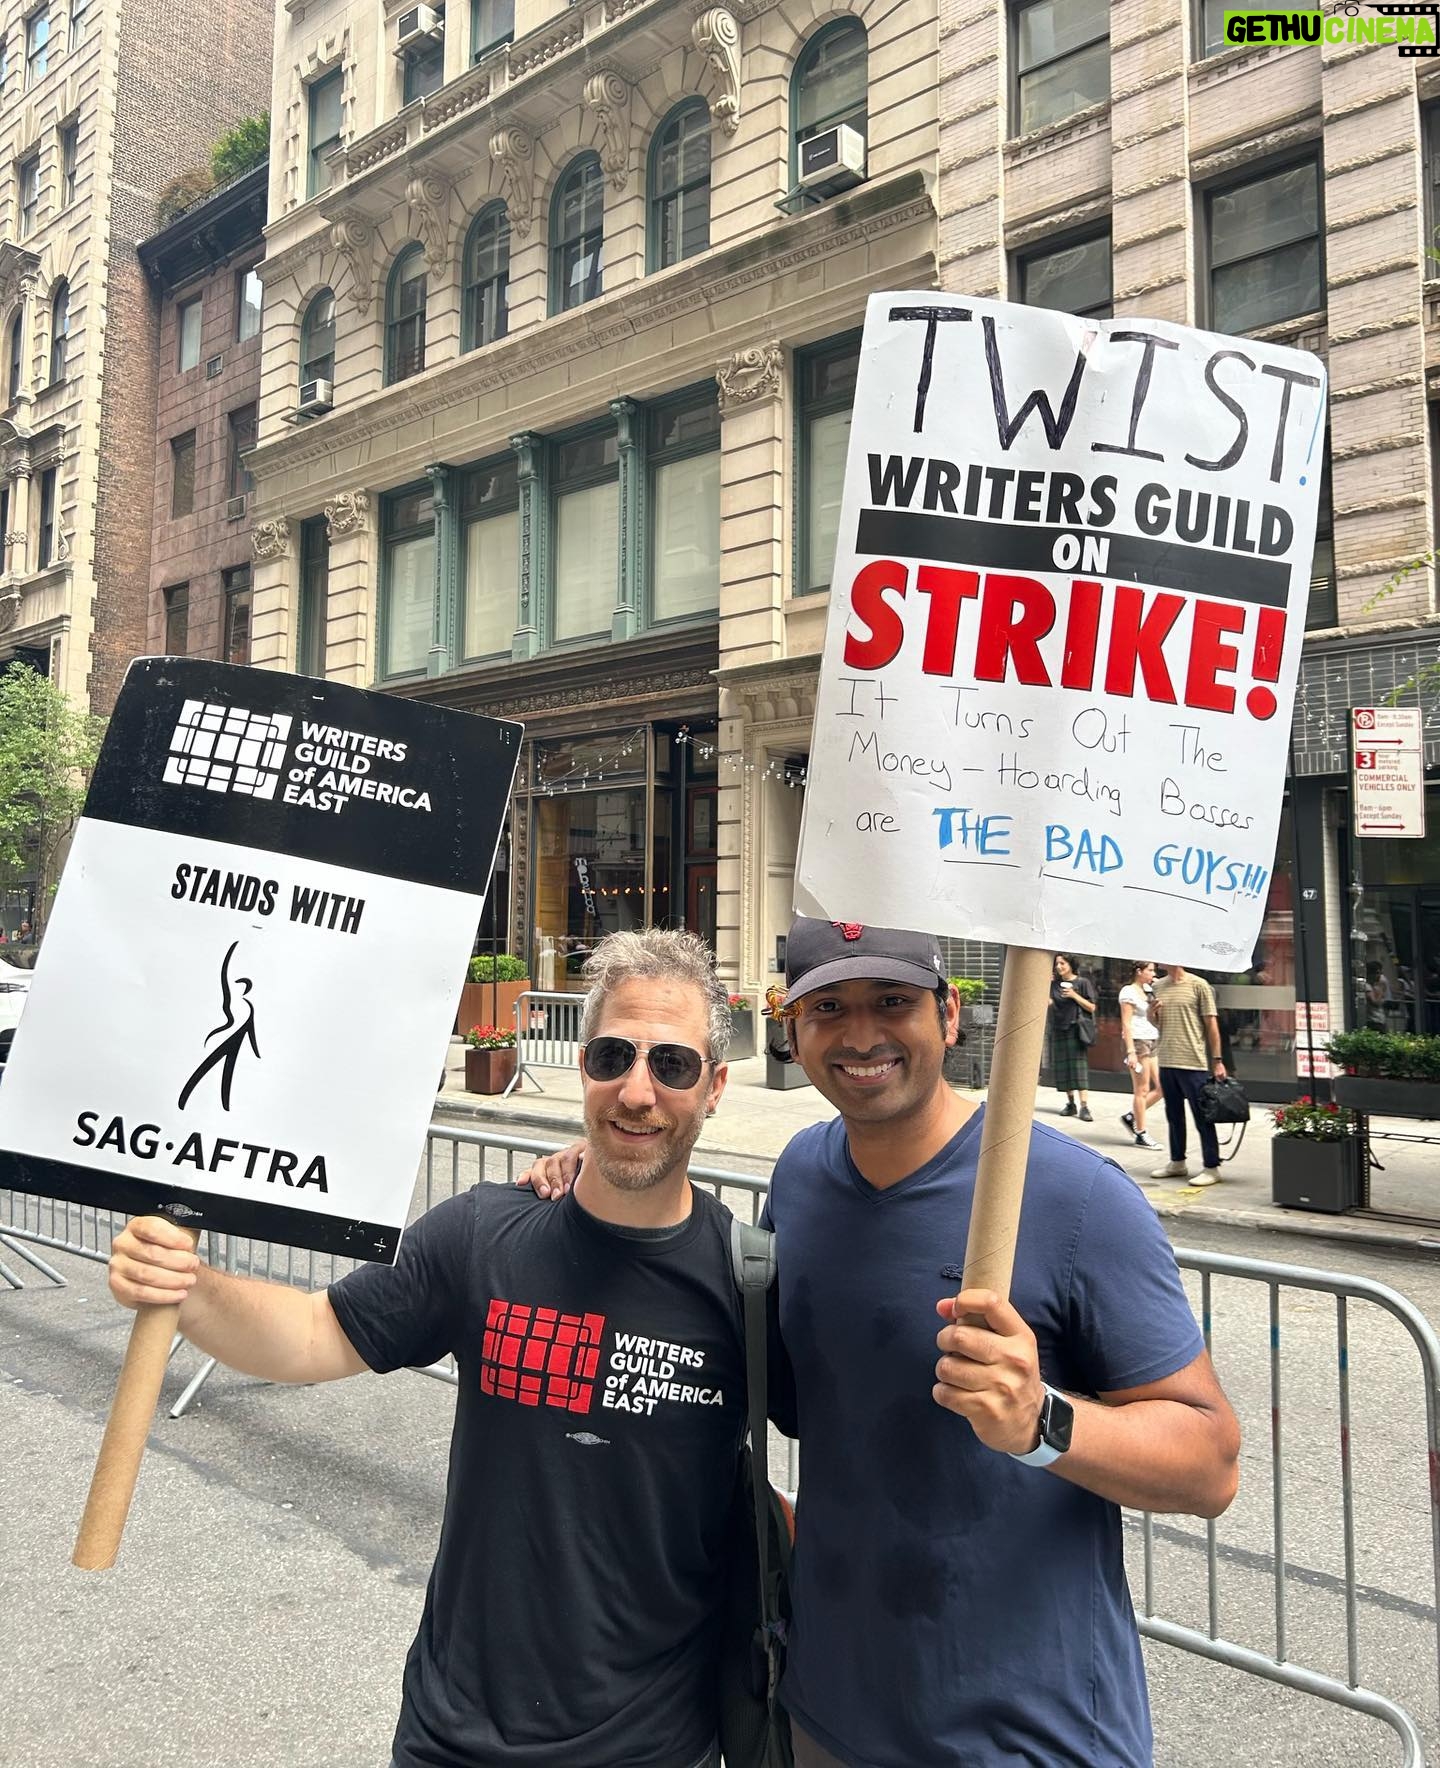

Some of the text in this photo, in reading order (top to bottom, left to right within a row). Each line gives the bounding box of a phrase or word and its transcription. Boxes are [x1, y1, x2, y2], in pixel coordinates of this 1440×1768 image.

[888, 306, 1327, 487] TWIST!
[867, 453, 1294, 558] WRITERS GUILD
[1051, 533, 1111, 575] ON
[843, 559, 1288, 721] STRIKE!
[300, 720, 409, 763] WRITERS
[836, 677, 1228, 772] It Turns Out The
[294, 743, 372, 776] GUILD
[1359, 774, 1409, 782] COMMERCIAL
[1360, 752, 1371, 768] 3
[282, 783, 350, 815] EAST
[288, 765, 433, 813] of AMERICA
[1161, 777, 1254, 830] Bosses
[1359, 783, 1416, 792] VEHICLES ONLY
[856, 811, 901, 833] are
[932, 807, 1014, 855] THE
[1045, 824, 1124, 874] BAD
[171, 862, 366, 935] STANDS WITH
[609, 1351, 676, 1380] GUILD
[614, 1331, 706, 1369] WRITERS
[602, 1389, 658, 1416] EAST
[605, 1374, 724, 1406] of AMERICA
